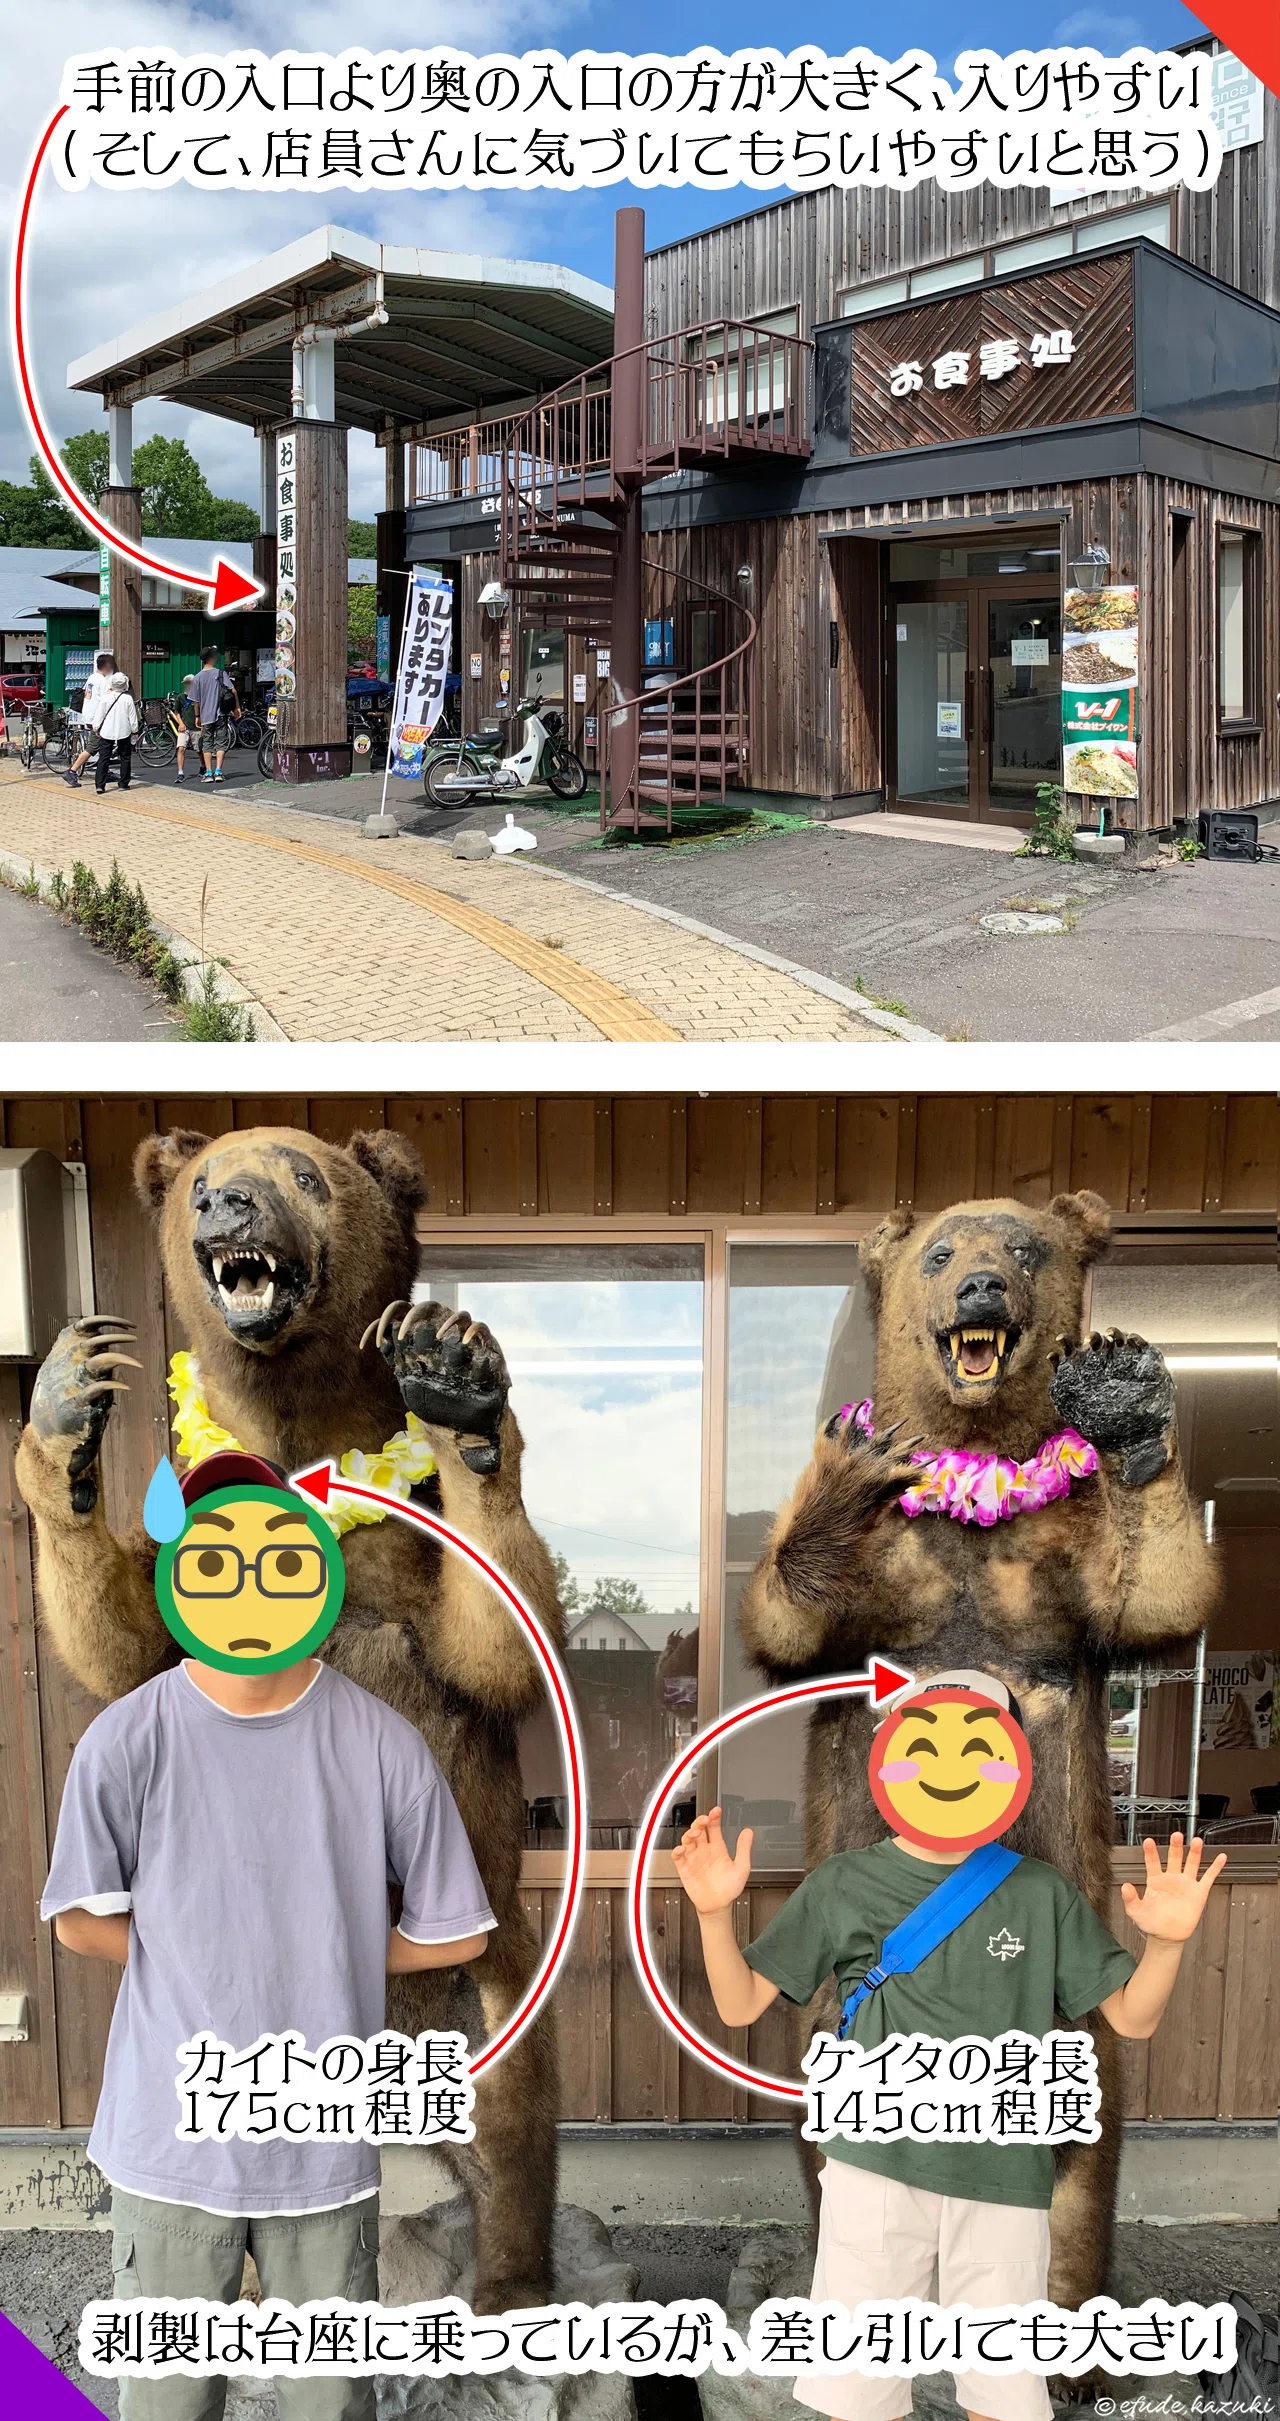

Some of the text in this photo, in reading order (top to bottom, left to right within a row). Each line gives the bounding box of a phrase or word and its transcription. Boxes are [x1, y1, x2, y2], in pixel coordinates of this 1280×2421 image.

[889, 329, 1076, 397] お食事処
[279, 441, 294, 579] お食事処
[419, 595, 452, 726] レンタカー
[597, 660, 610, 677] BIG
[1074, 697, 1122, 720] V-1
[1066, 721, 1129, 732] 株式会社ブイワン
[308, 751, 330, 765] V-1
[316, 764, 331, 773] Inc.
[1204, 1667, 1250, 1686] CHOCO
[1202, 1686, 1236, 1705] LATE
